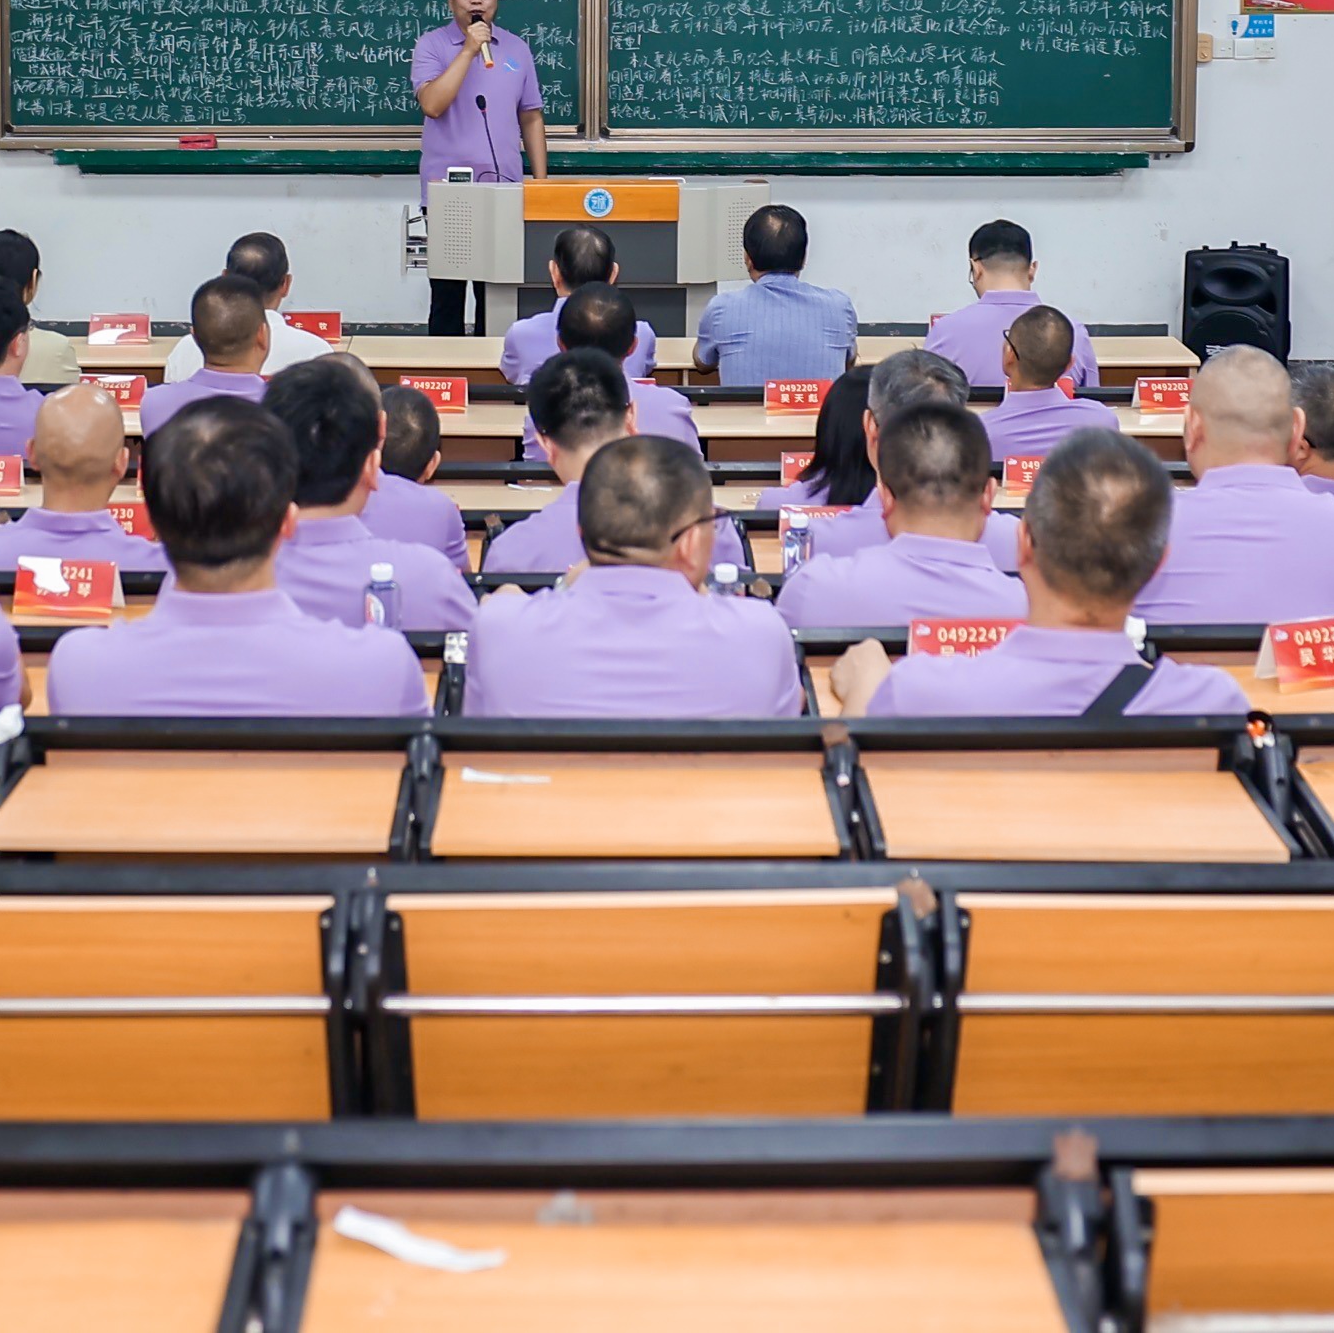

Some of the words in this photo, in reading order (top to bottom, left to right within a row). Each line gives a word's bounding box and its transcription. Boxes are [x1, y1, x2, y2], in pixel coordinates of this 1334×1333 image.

[414, 381, 453, 390] 0492207
[780, 383, 818, 391] 0492205
[1151, 382, 1189, 391] 0492203
[937, 626, 1007, 642] 0492247
